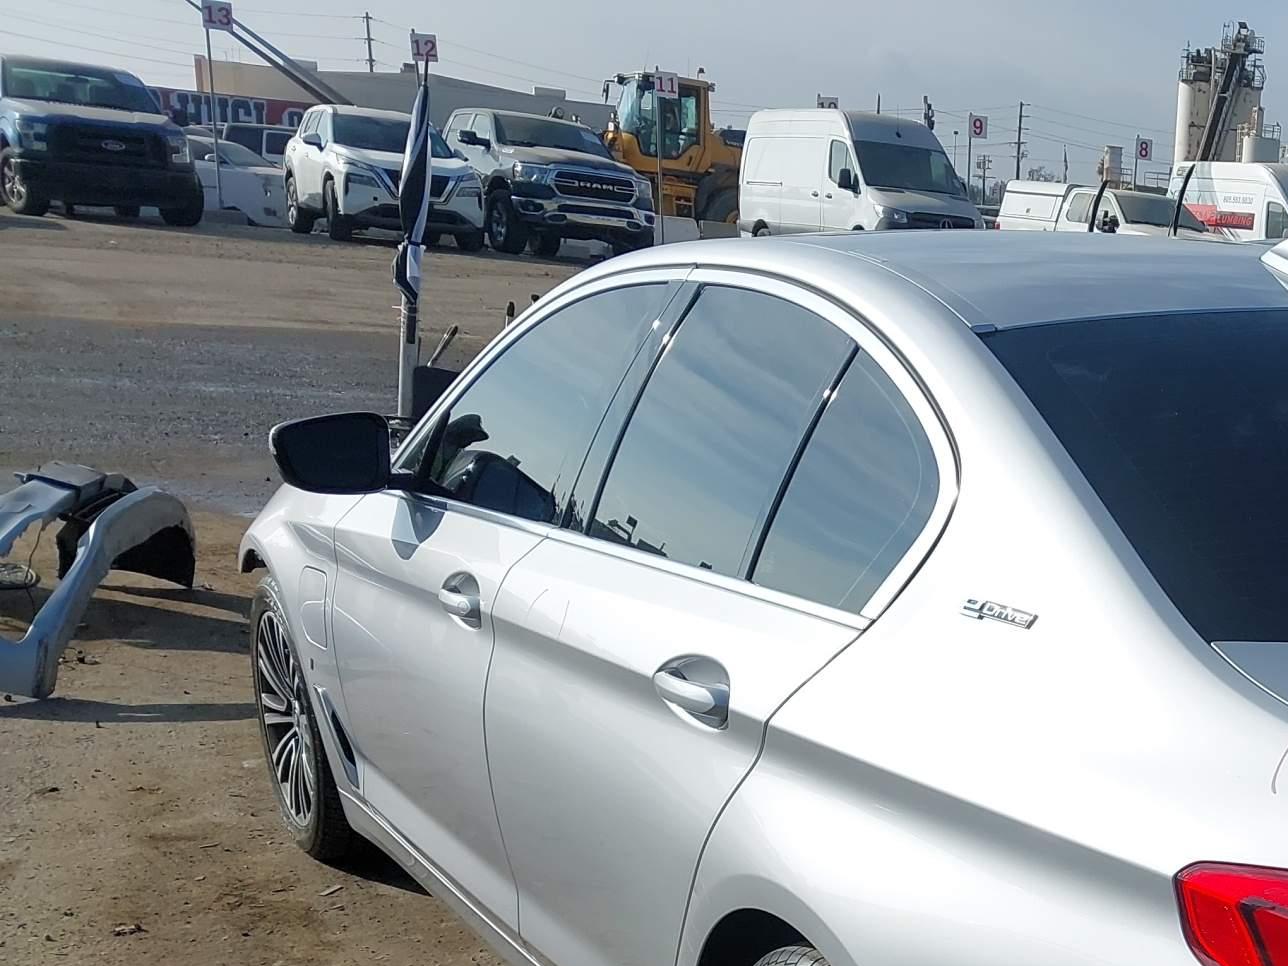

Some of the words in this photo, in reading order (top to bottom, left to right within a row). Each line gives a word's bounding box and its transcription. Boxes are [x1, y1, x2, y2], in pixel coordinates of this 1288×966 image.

[203, 5, 231, 26] 13
[412, 39, 438, 58] 12
[655, 76, 677, 94] 11
[973, 118, 983, 136] 9
[1139, 141, 1149, 158] 8
[580, 181, 614, 191] RAM
